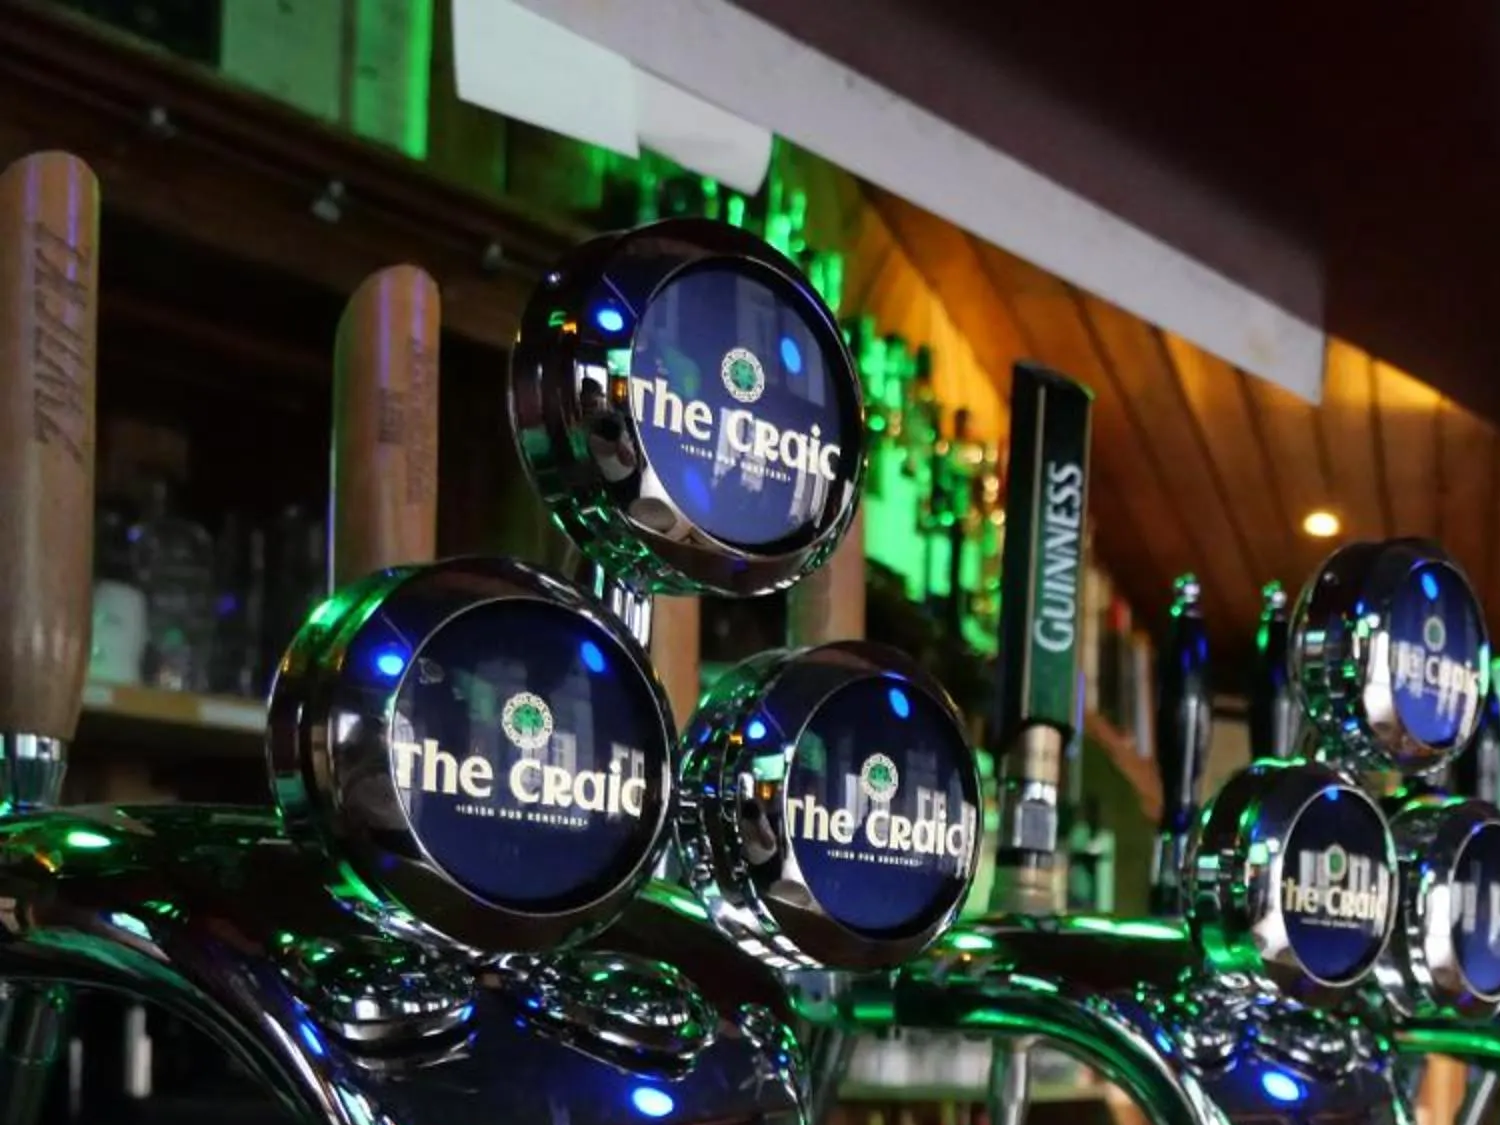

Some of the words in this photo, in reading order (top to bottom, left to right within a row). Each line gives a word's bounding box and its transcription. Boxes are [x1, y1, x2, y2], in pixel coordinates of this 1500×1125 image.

[630, 376, 713, 440] The
[1034, 460, 1083, 653] GUINNESS
[391, 739, 493, 798] The
[509, 758, 647, 817] Craic
[787, 794, 854, 845] The
